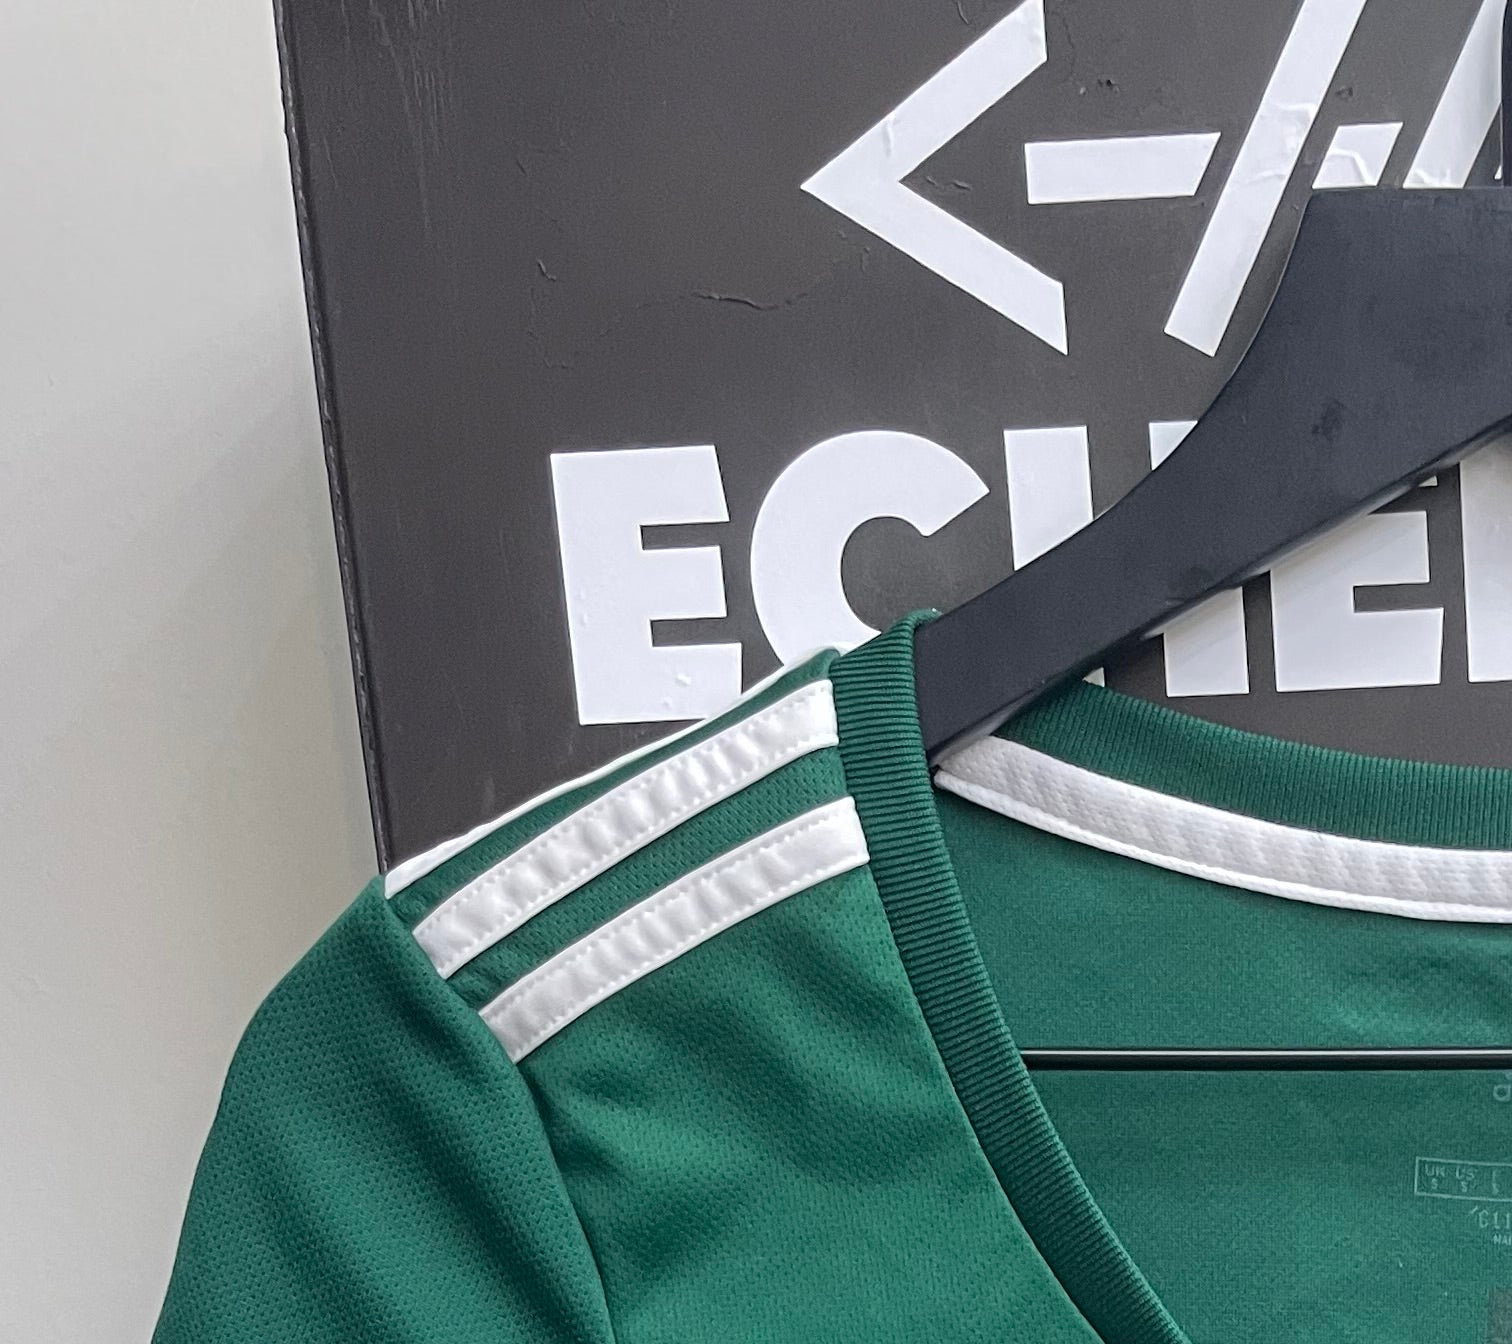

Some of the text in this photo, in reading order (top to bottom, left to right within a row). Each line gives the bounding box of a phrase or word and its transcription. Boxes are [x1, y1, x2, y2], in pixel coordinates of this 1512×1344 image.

[1425, 1164, 1445, 1177] UK
[1456, 1166, 1476, 1180] US
[1431, 1178, 1439, 1190] S
[1461, 1181, 1469, 1193] S
